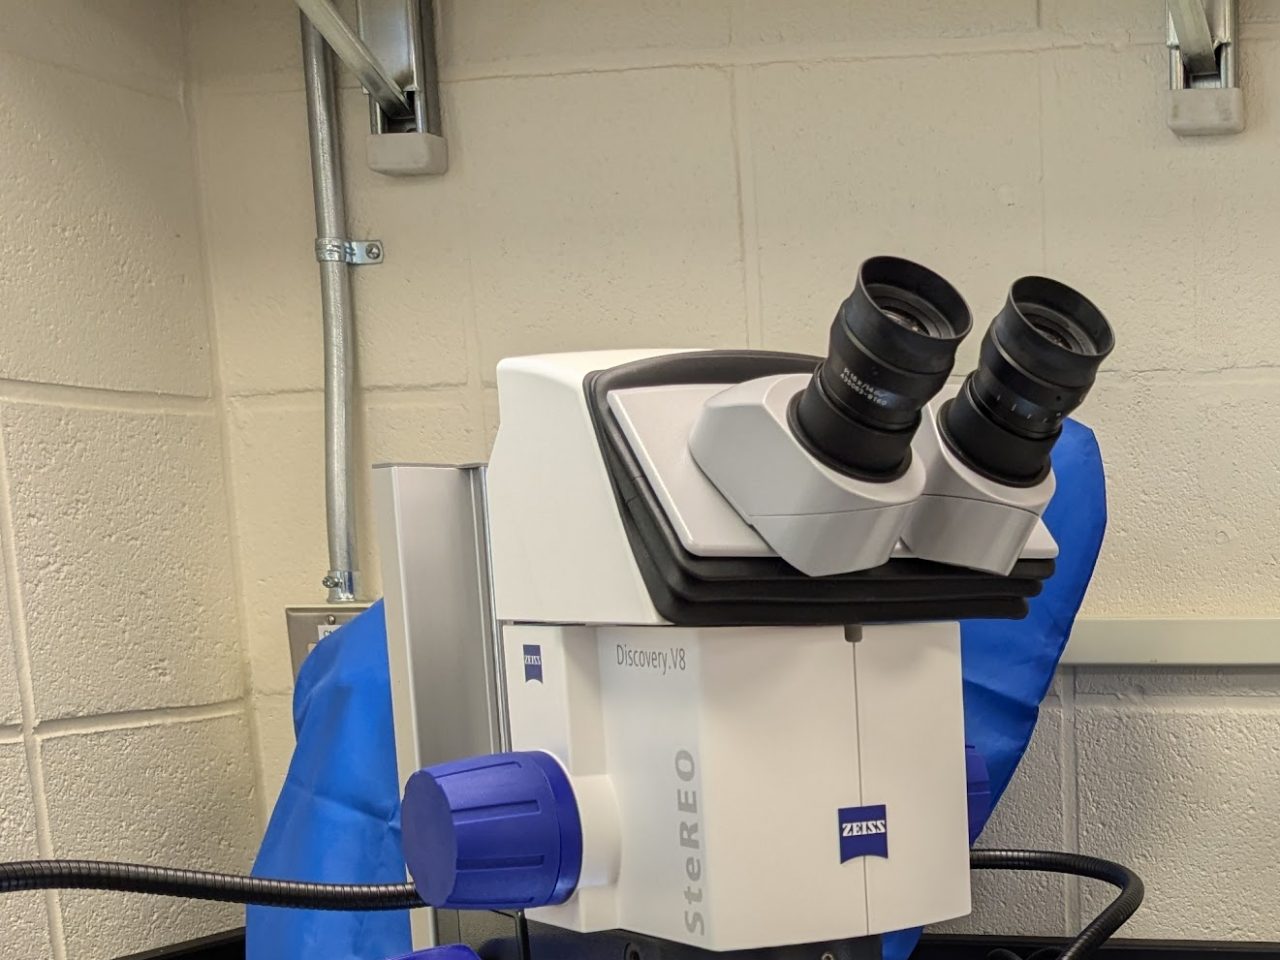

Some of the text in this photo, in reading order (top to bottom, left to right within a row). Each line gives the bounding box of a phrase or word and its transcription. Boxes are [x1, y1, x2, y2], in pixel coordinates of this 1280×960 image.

[616, 643, 686, 676] Discovery.V8
[674, 750, 704, 936] SteREO
[842, 820, 886, 837] ZEISS
